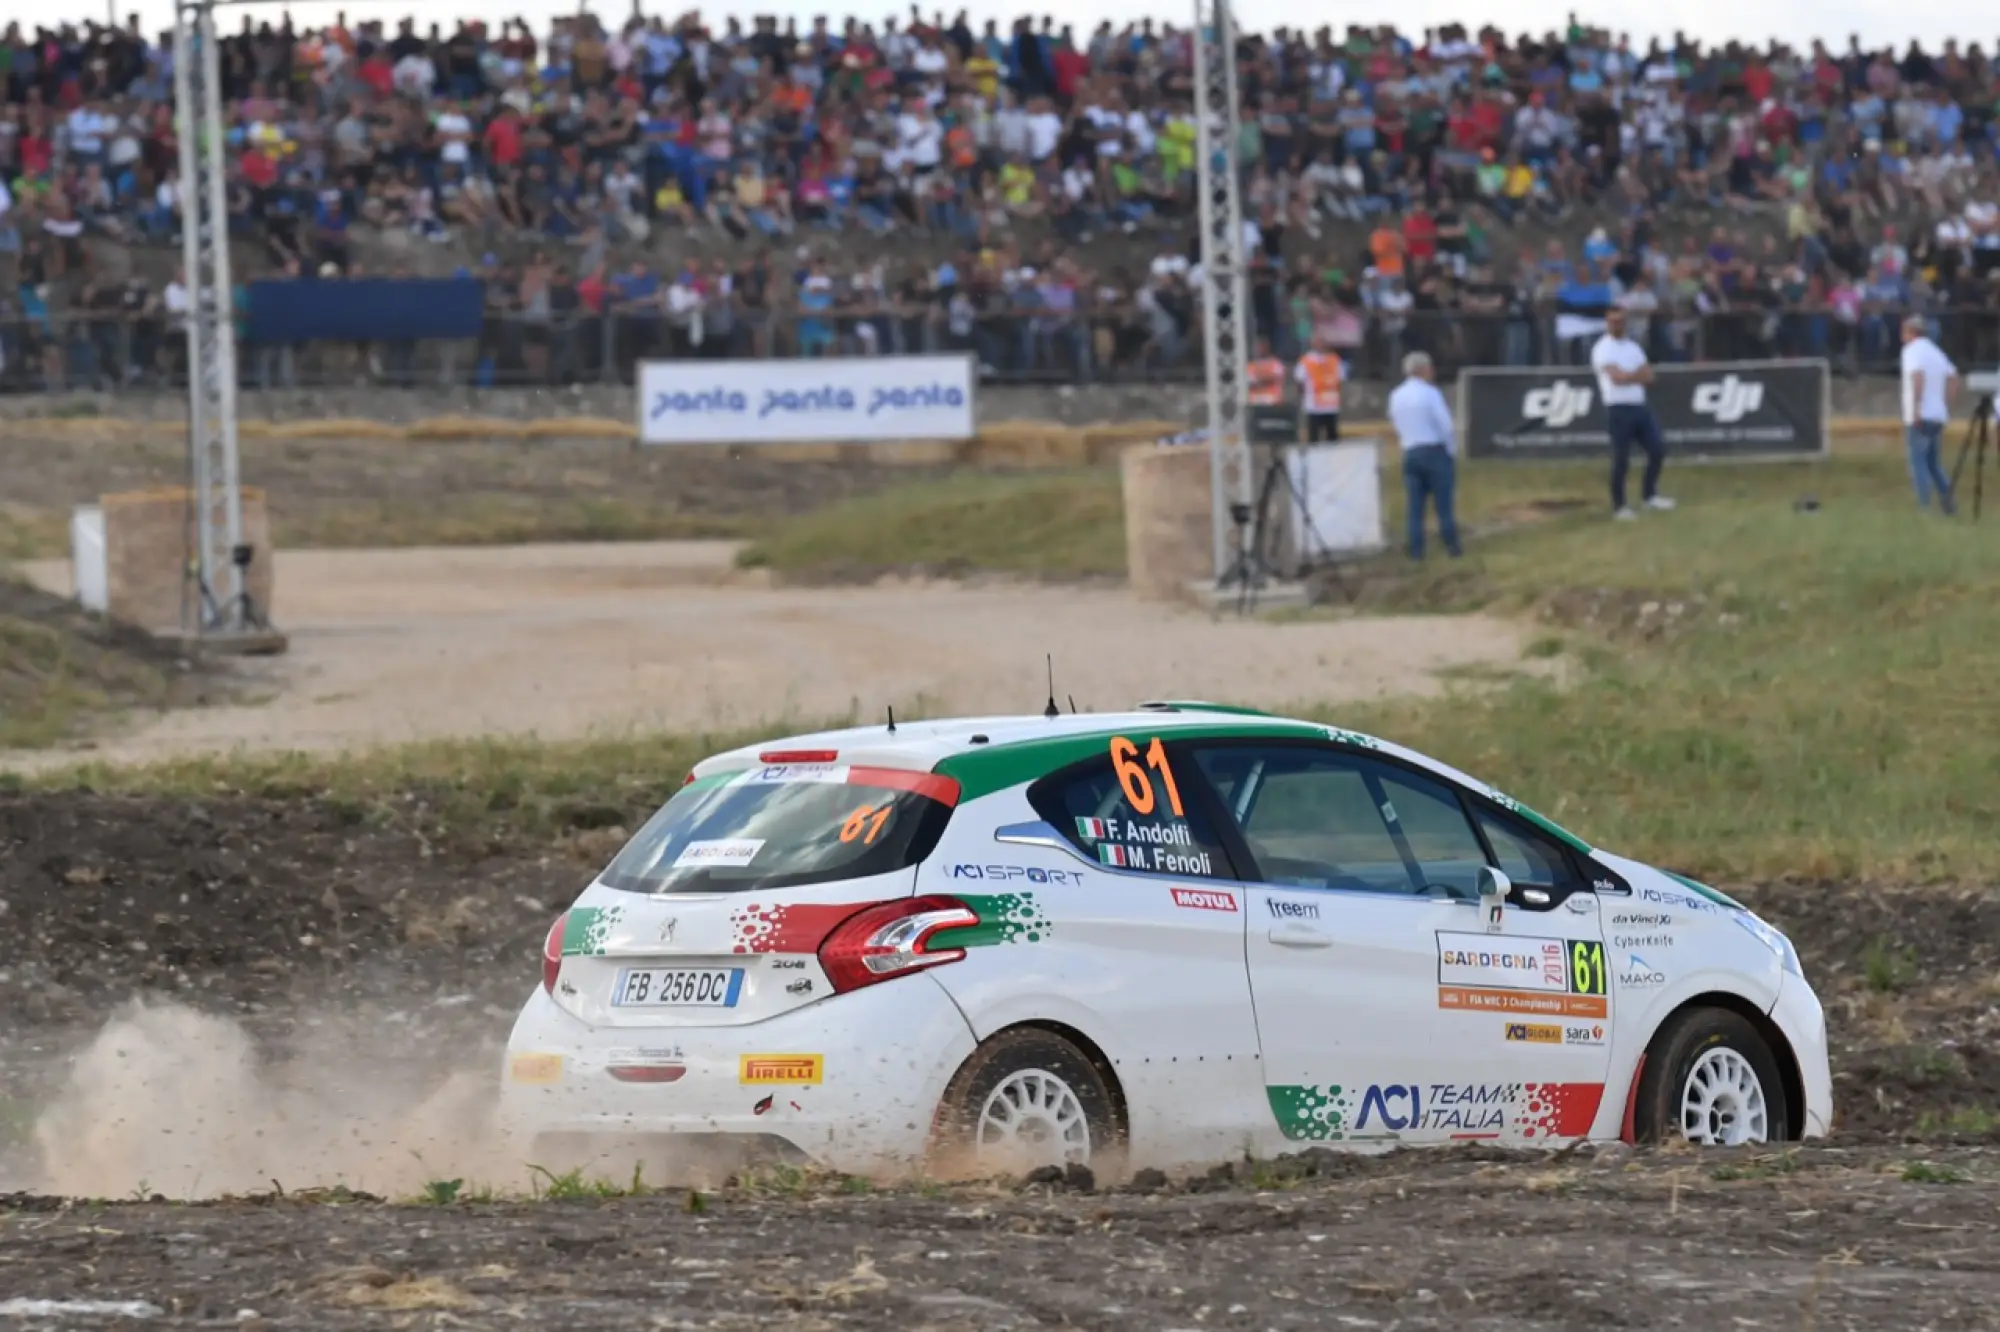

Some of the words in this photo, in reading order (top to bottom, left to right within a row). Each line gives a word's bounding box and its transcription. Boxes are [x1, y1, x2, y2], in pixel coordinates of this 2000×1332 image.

[1110, 736, 1184, 816] 61
[840, 805, 893, 844] 61
[1106, 819, 1122, 841] F.
[1127, 820, 1191, 846] Andolfi
[1128, 847, 1150, 870] M.
[1155, 851, 1212, 875] Fenoli
[1176, 890, 1236, 910] MOTUL
[1267, 897, 1320, 918] freem
[1614, 934, 1673, 949] CyberKnife
[1444, 951, 1538, 971] SARDEGNA
[1541, 944, 1563, 985] 2016
[1574, 941, 1604, 994] 61
[624, 972, 651, 1002] FB
[1620, 972, 1665, 984] MAKO
[1510, 998, 1562, 1012] Championship
[1566, 1027, 1590, 1040] sara
[747, 1059, 814, 1079] PIRELLI
[1429, 1085, 1500, 1104] TEAM
[1354, 1084, 1420, 1130] ACI
[1420, 1109, 1504, 1129] ITALIA
